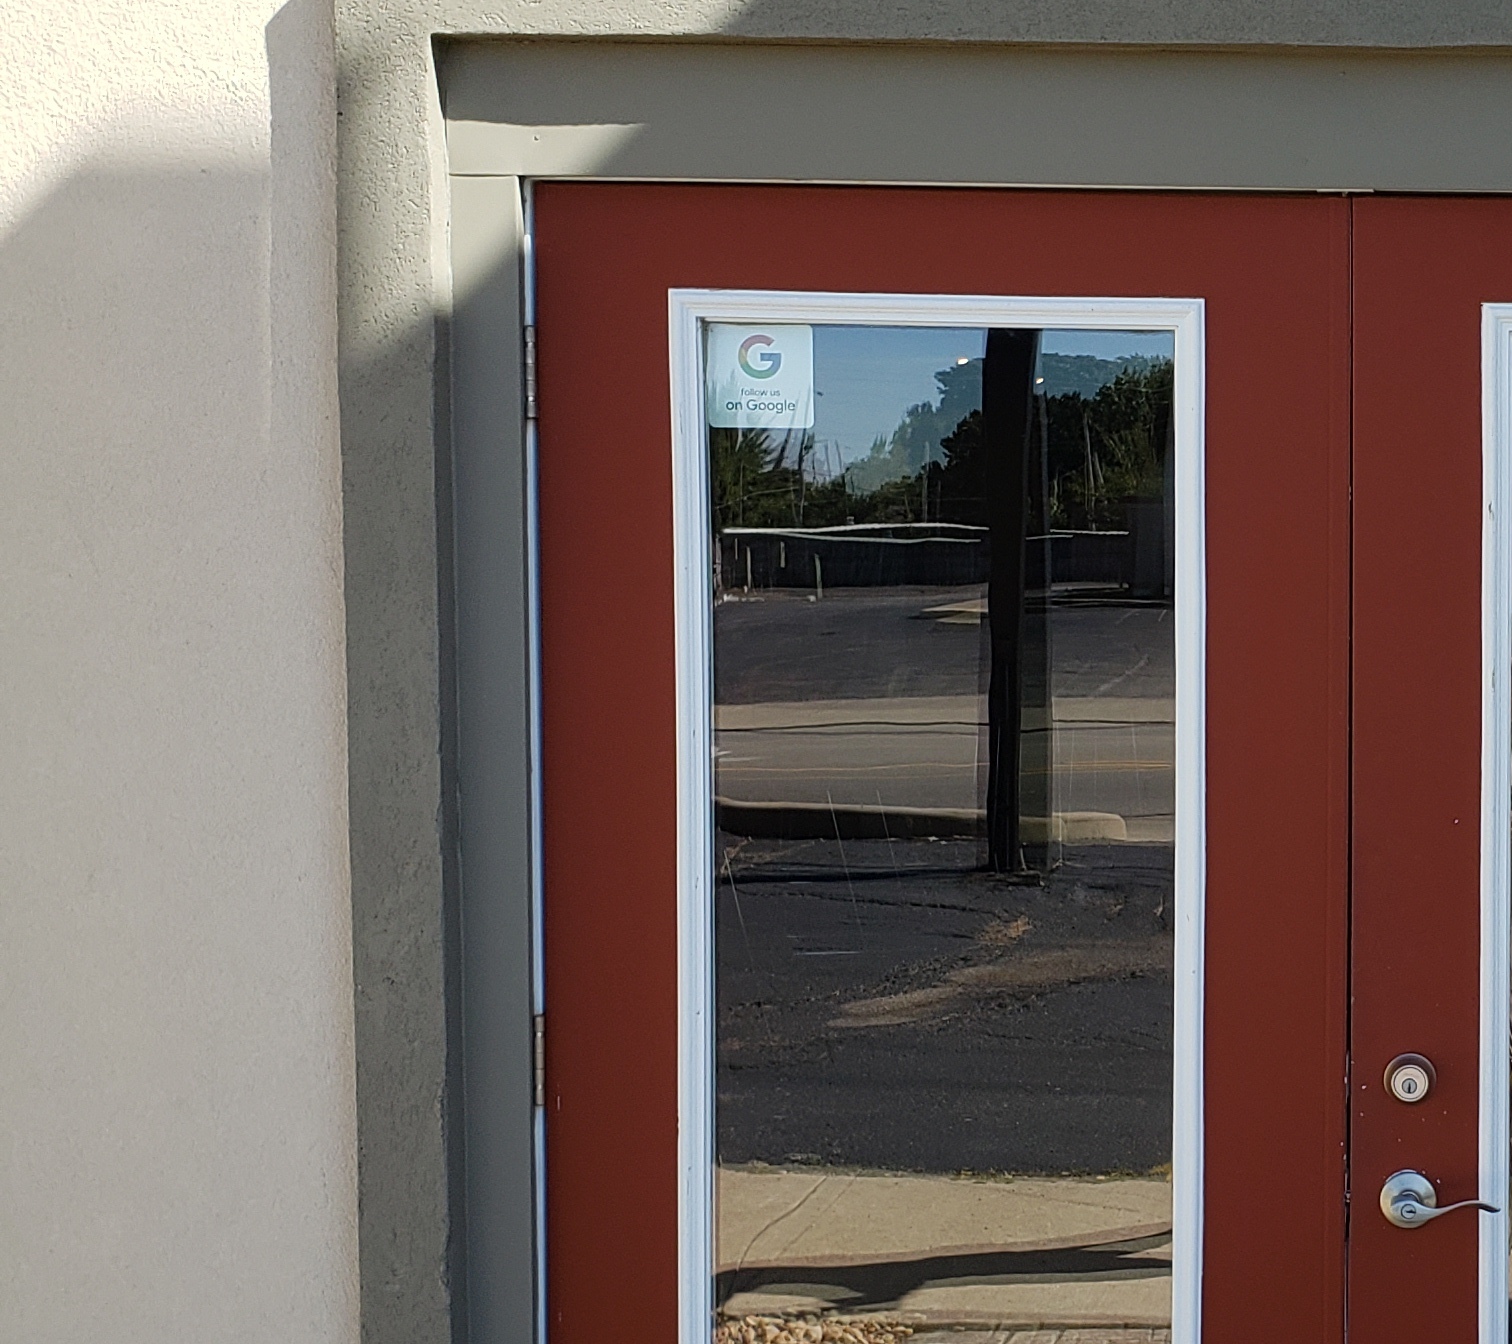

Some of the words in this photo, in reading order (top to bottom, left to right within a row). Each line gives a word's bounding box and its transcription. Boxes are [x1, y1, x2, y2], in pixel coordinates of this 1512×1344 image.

[741, 388, 767, 397] follow
[770, 389, 780, 397] us
[726, 401, 743, 411] on
[746, 399, 796, 414] Google
